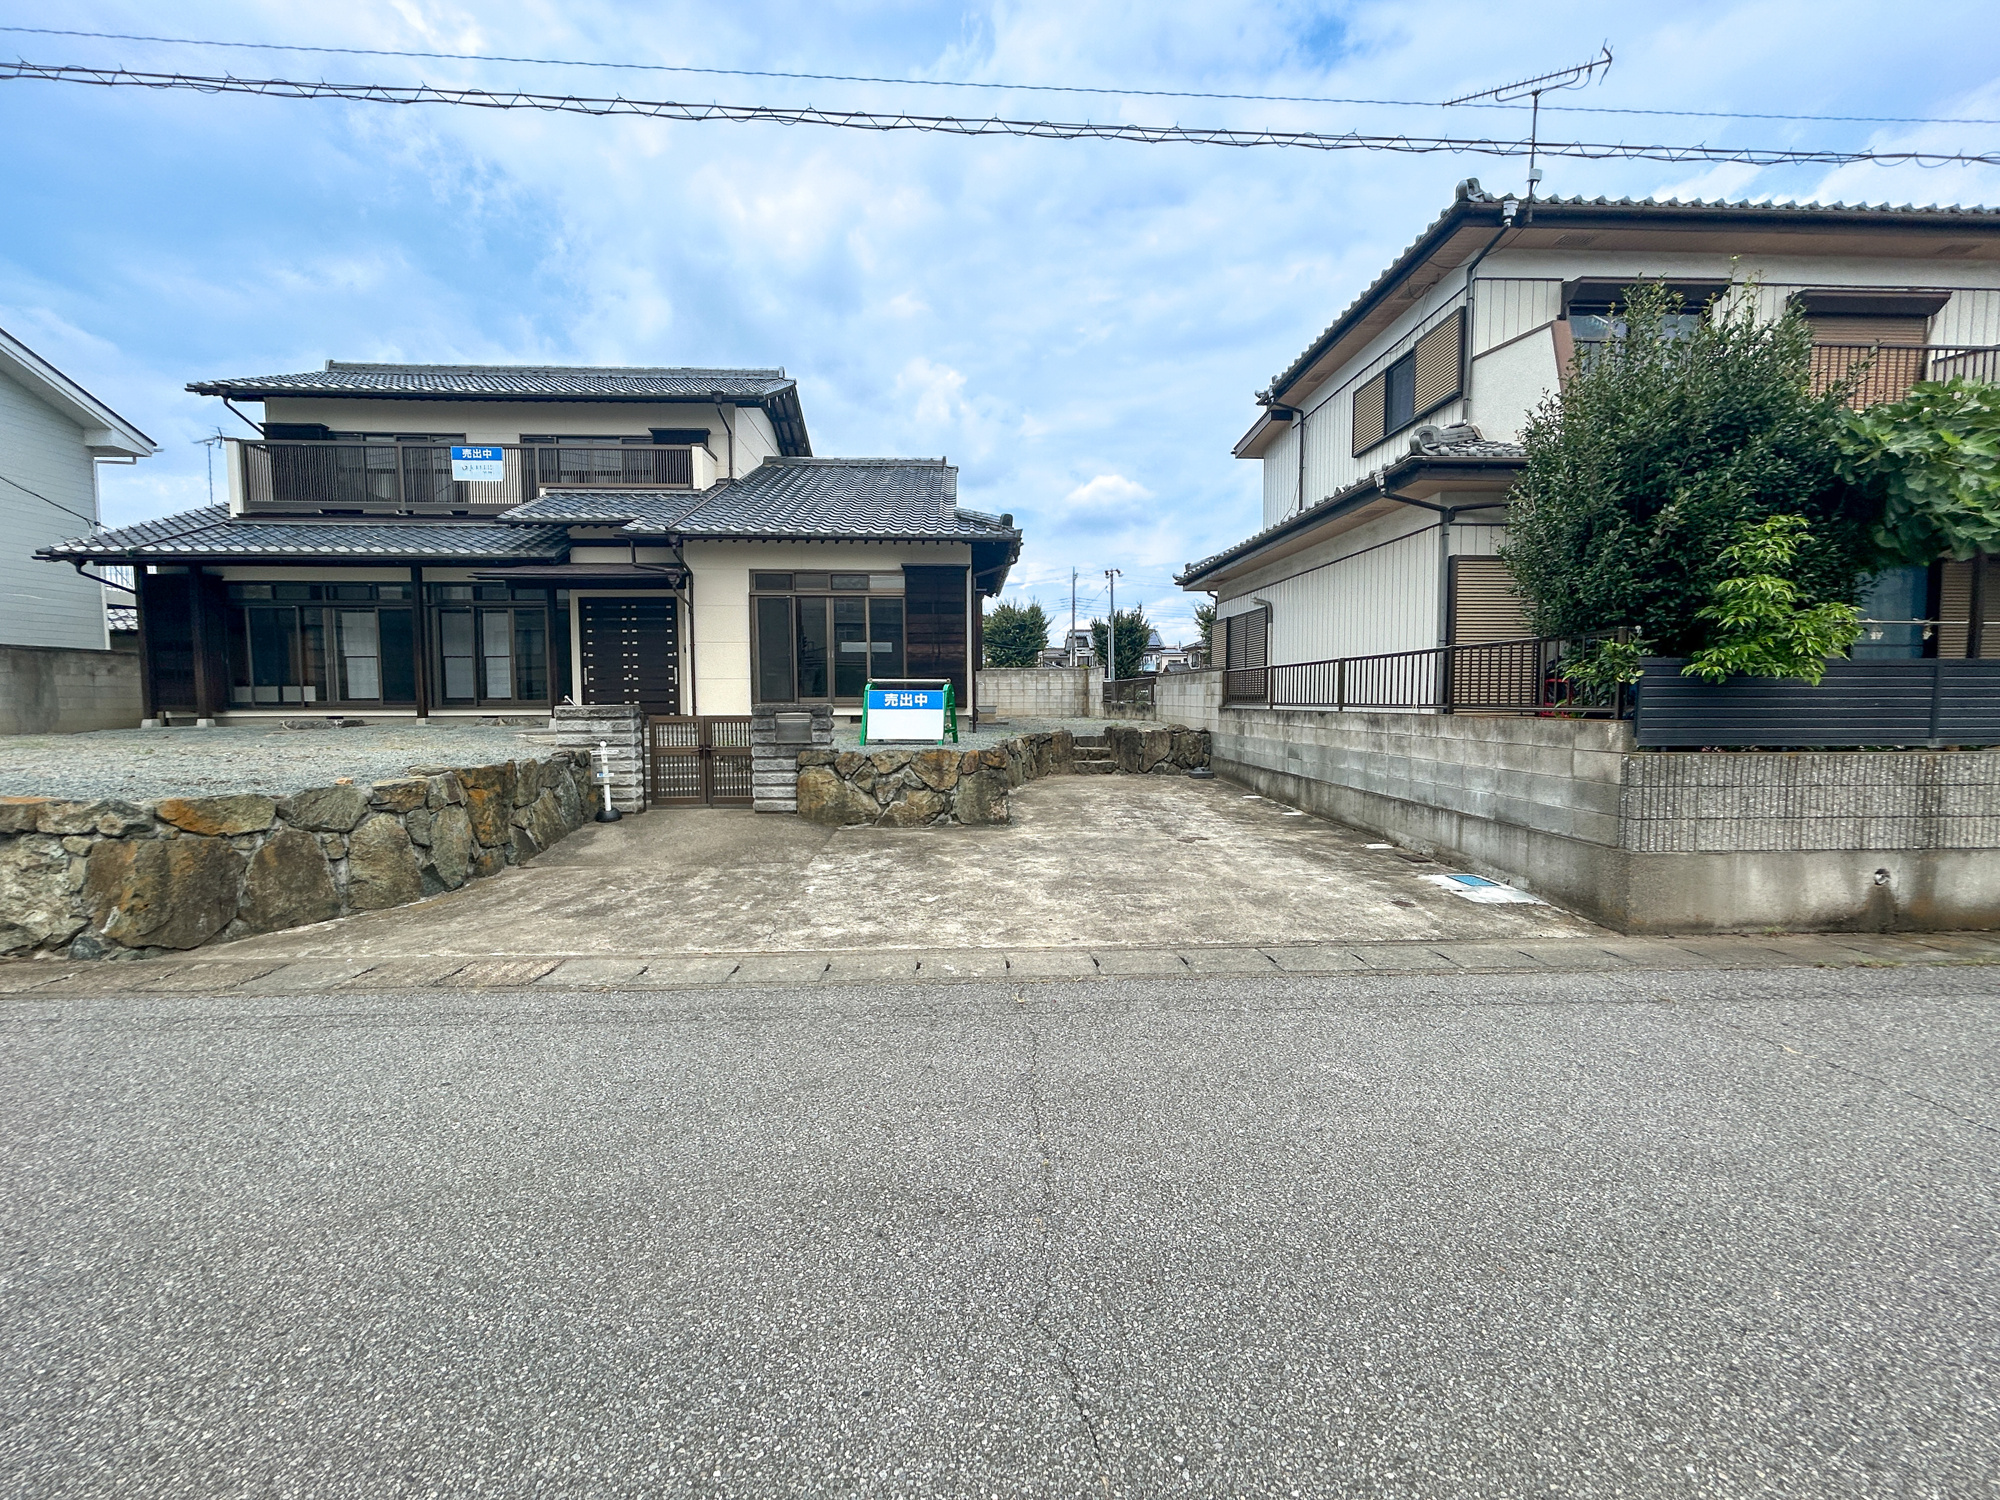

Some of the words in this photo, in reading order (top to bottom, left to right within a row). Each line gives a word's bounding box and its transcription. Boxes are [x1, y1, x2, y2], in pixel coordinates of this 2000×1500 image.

[461, 448, 492, 459] 売出中
[884, 693, 928, 707] 売出中
